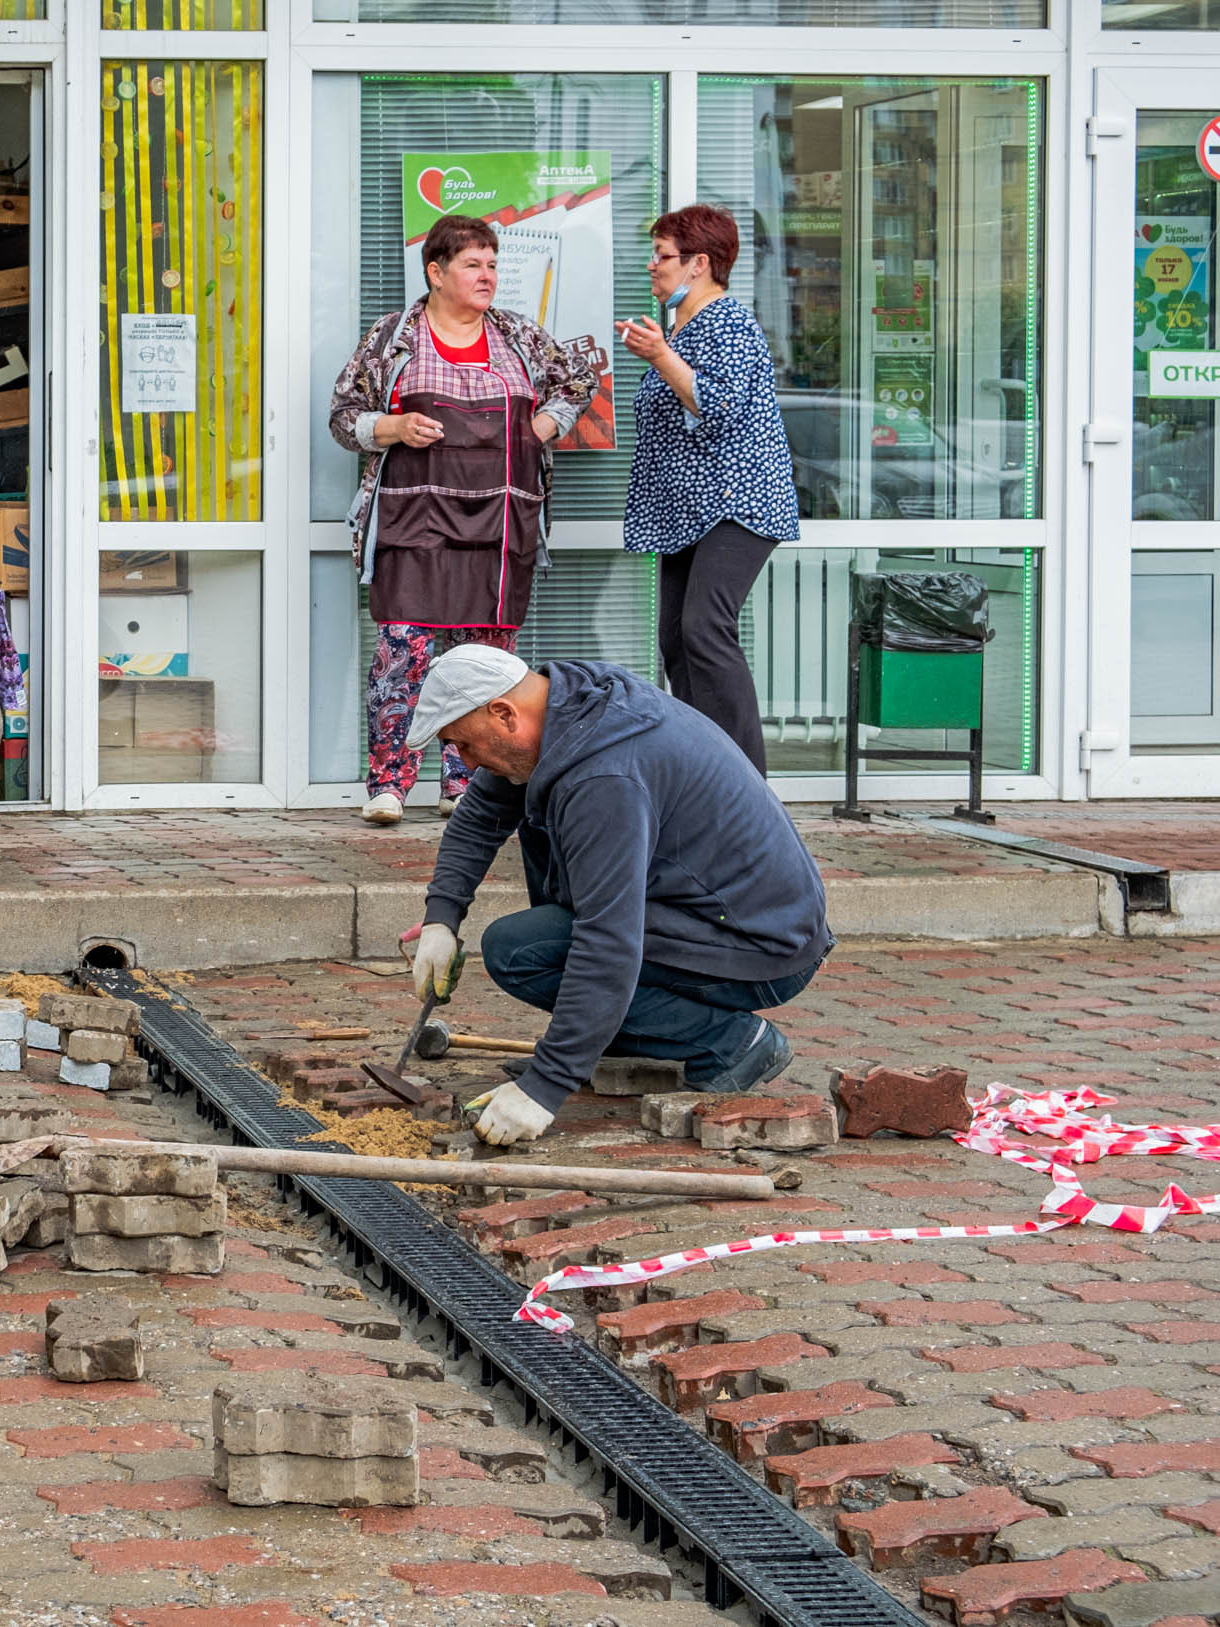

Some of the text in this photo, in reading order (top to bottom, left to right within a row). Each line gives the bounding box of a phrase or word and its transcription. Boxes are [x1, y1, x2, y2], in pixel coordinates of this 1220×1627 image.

[444, 179, 476, 190] Будь
[445, 190, 497, 201] здоров!
[1165, 224, 1189, 235] Будь
[1161, 263, 1176, 275] 17
